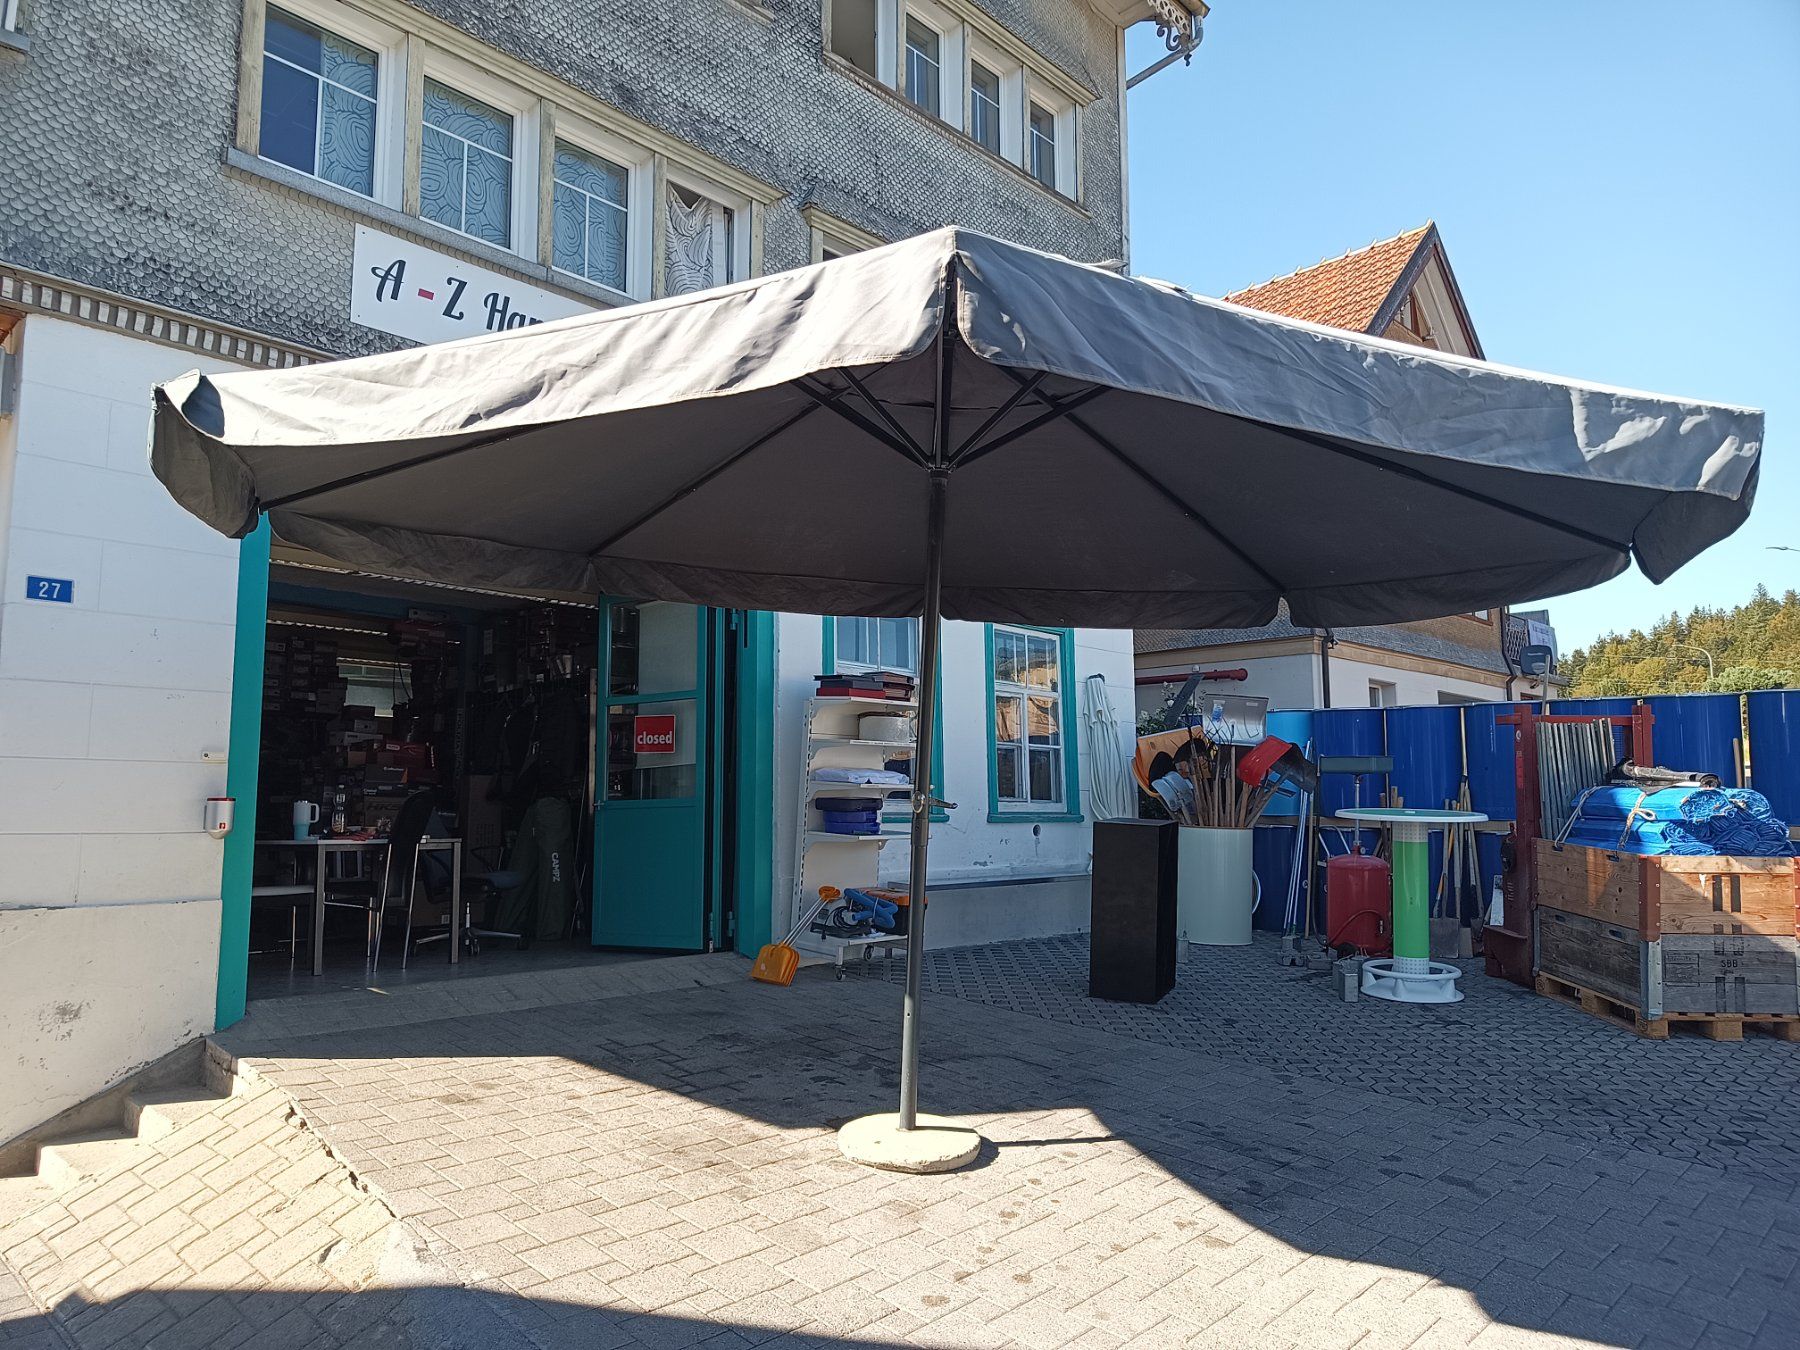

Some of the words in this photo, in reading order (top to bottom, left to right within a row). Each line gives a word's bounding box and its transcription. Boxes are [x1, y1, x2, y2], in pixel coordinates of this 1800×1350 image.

[370, 259, 407, 302] A
[442, 277, 468, 321] Z
[38, 581, 61, 599] 27
[637, 731, 673, 745] closed
